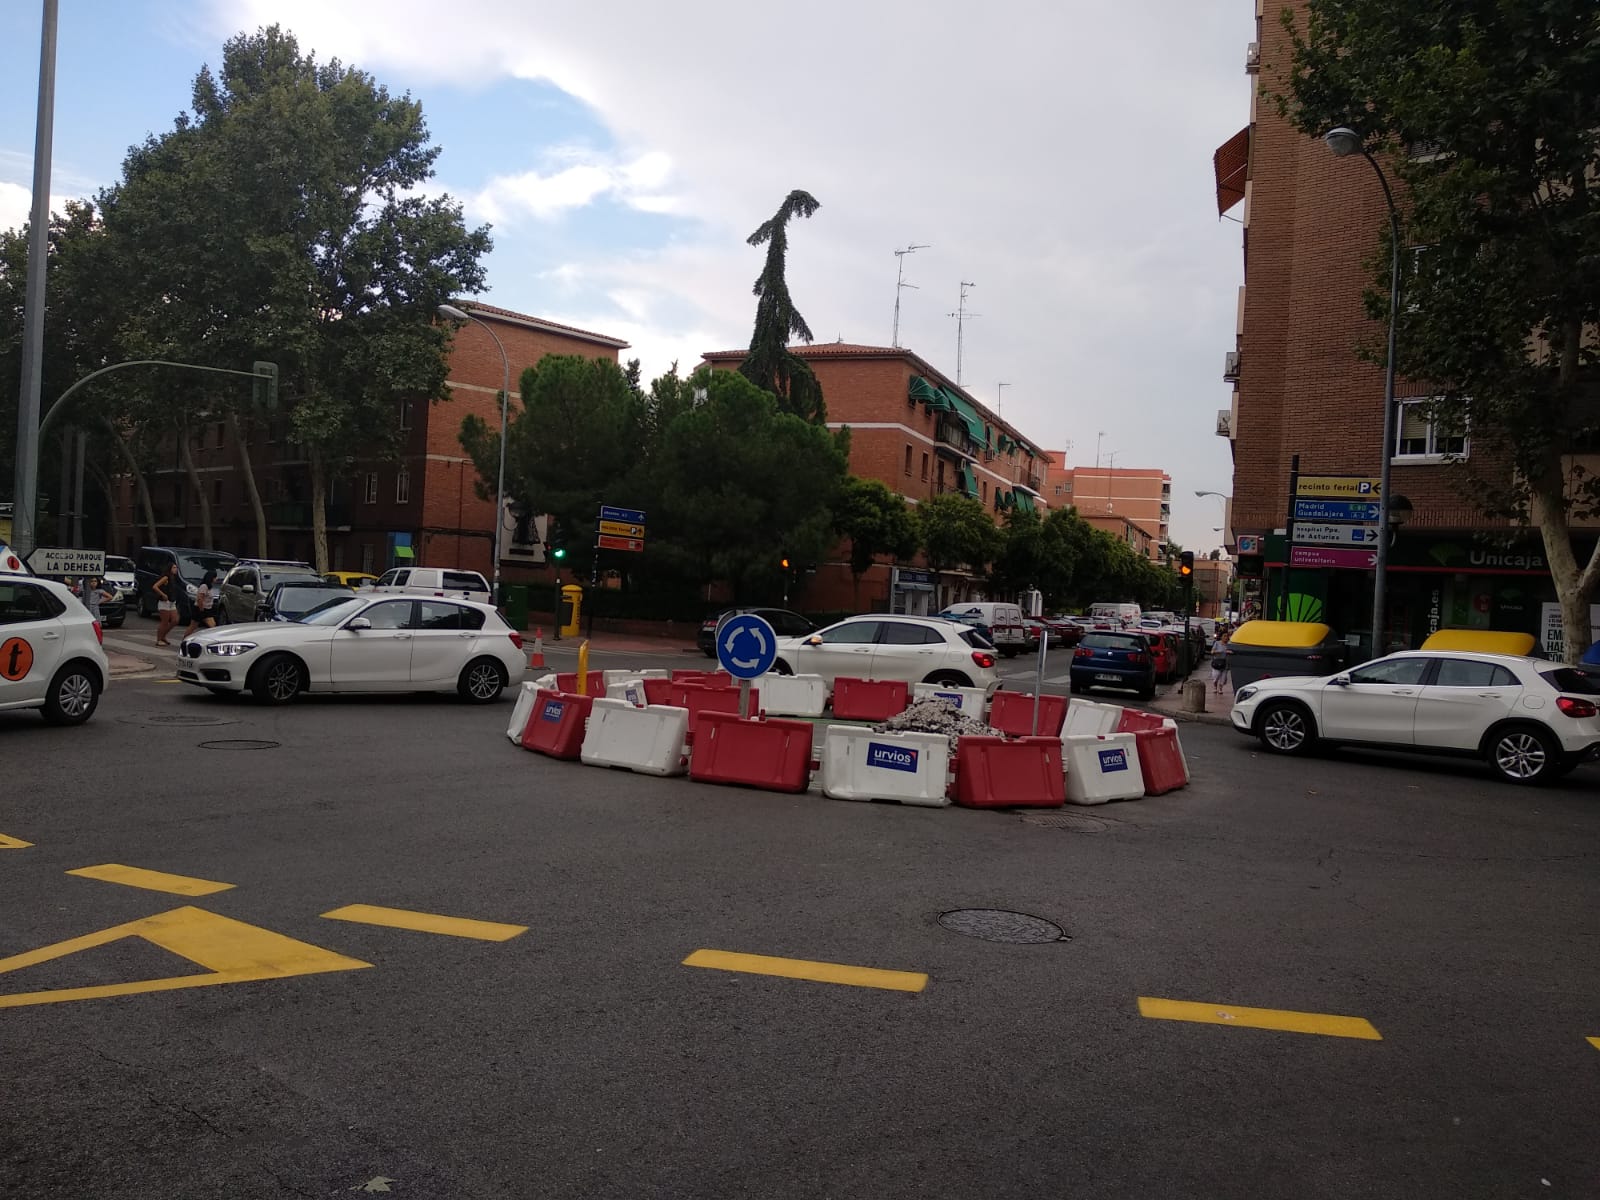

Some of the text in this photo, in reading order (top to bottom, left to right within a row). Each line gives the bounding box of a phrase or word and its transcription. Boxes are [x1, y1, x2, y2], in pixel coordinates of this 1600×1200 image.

[1333, 483, 1359, 491] ferial
[76, 553, 102, 561] PARQUE
[1470, 550, 1543, 569] Unicaja
[47, 562, 101, 572] LA DEHESA
[8, 642, 23, 676] t
[873, 749, 912, 763] urvios
[1102, 753, 1123, 765] urvios
